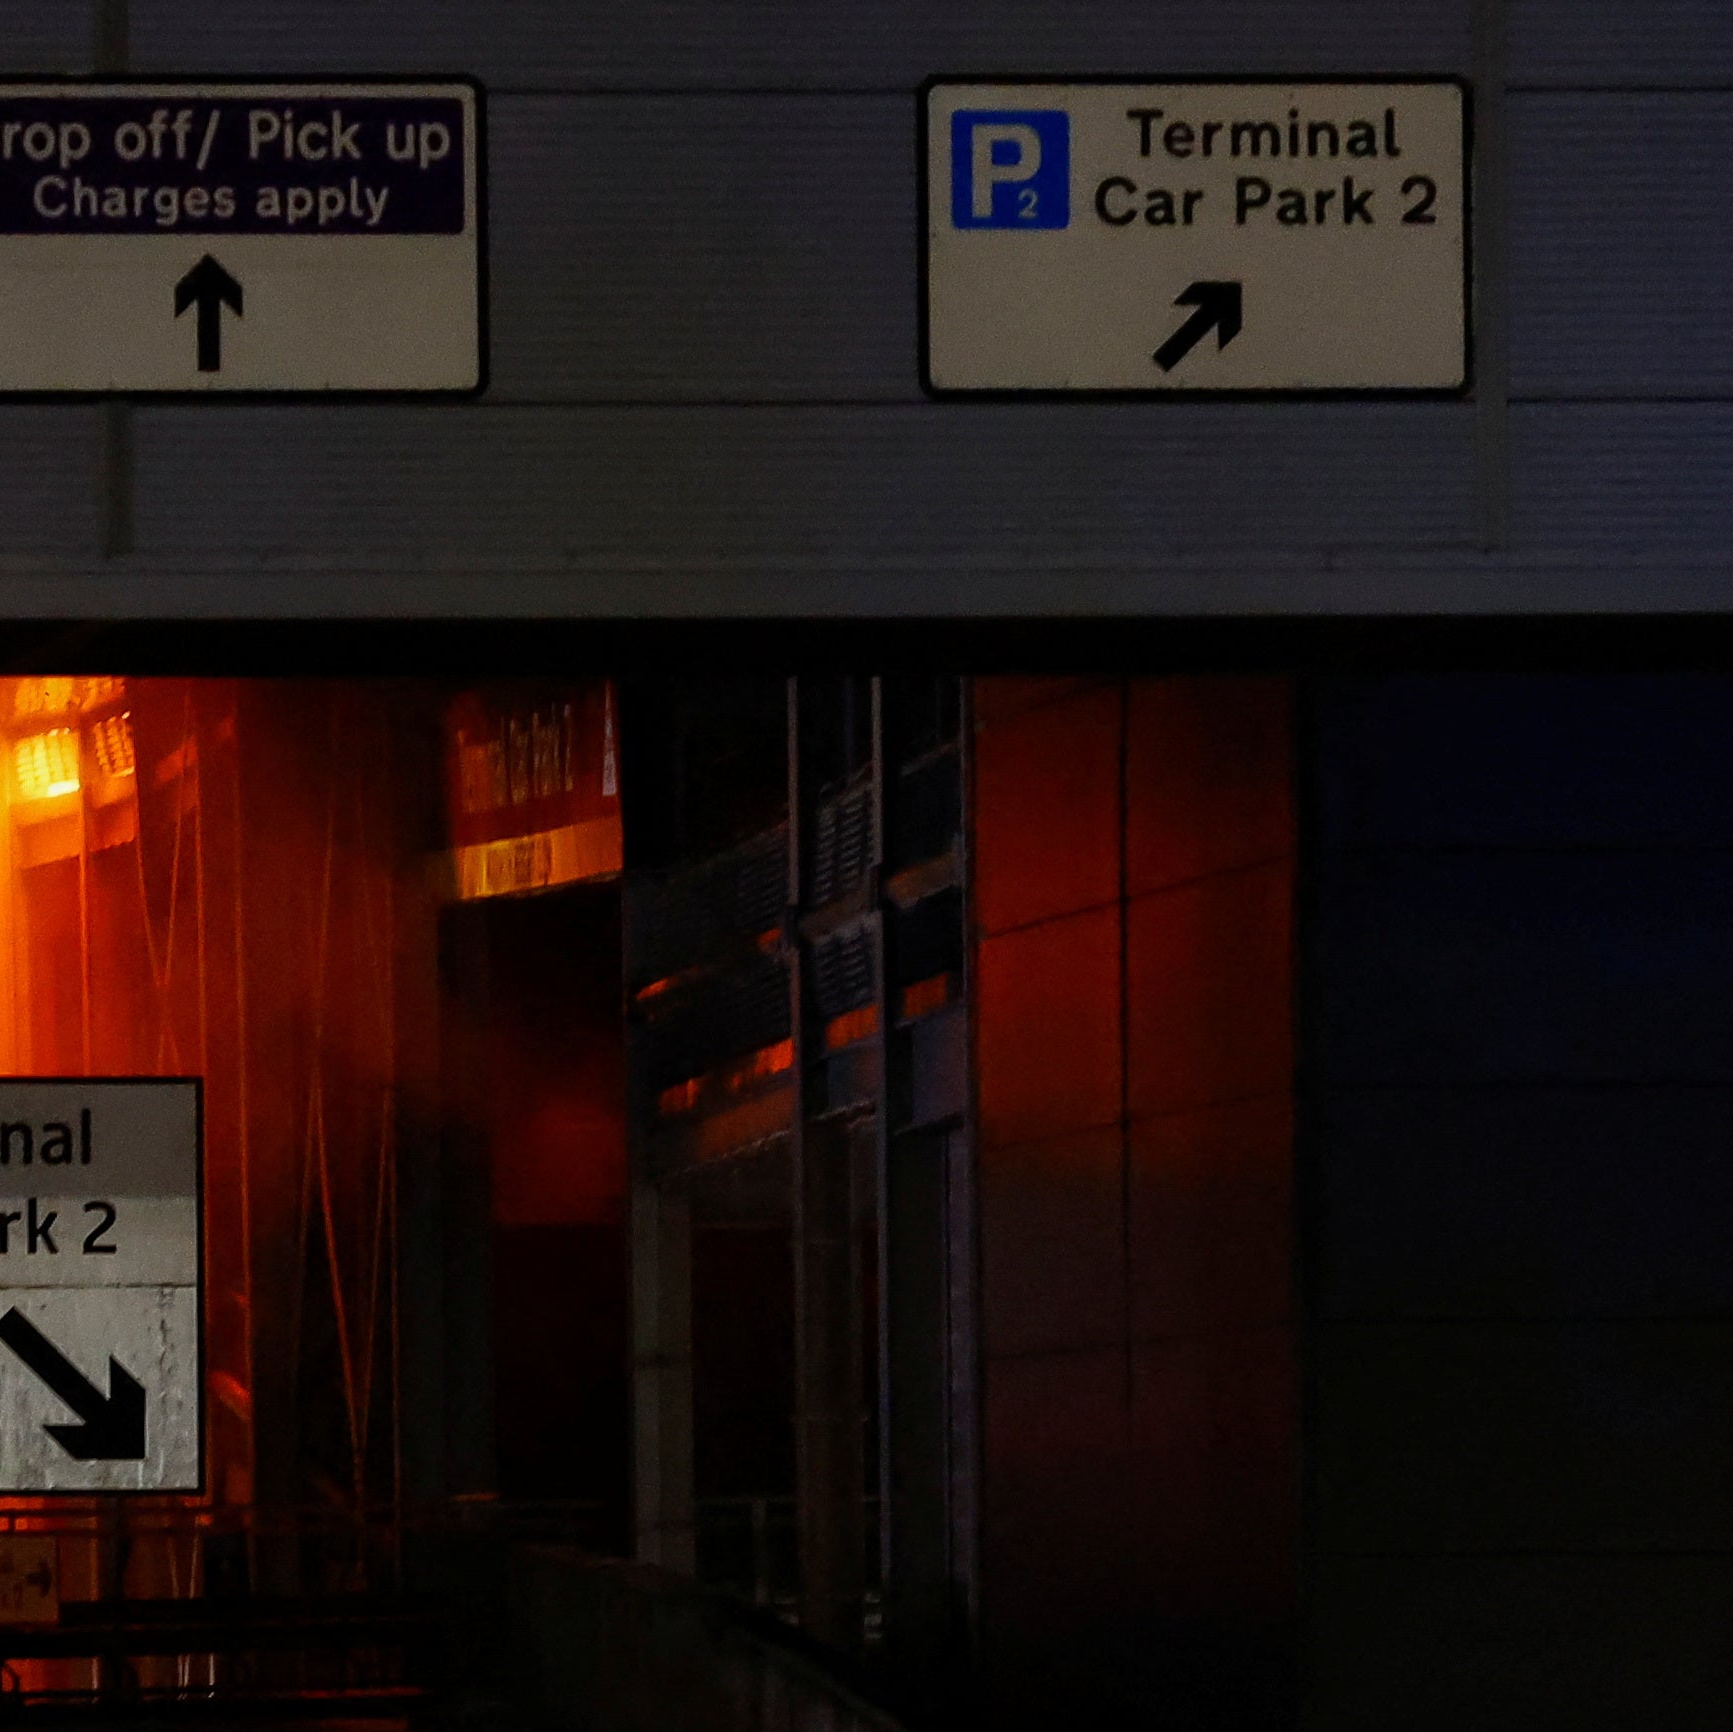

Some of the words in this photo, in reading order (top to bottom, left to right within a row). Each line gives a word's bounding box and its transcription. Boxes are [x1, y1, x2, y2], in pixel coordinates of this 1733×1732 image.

[114, 108, 221, 171] off/
[248, 109, 361, 160] Pick
[385, 122, 451, 168] up
[1127, 108, 1400, 158] Terminal
[33, 175, 236, 227] Charges
[256, 177, 390, 226] apply
[1094, 175, 1203, 226] Car
[1235, 176, 1375, 226] Park
[1401, 174, 1438, 225] 2
[82, 1202, 118, 1255] 2
